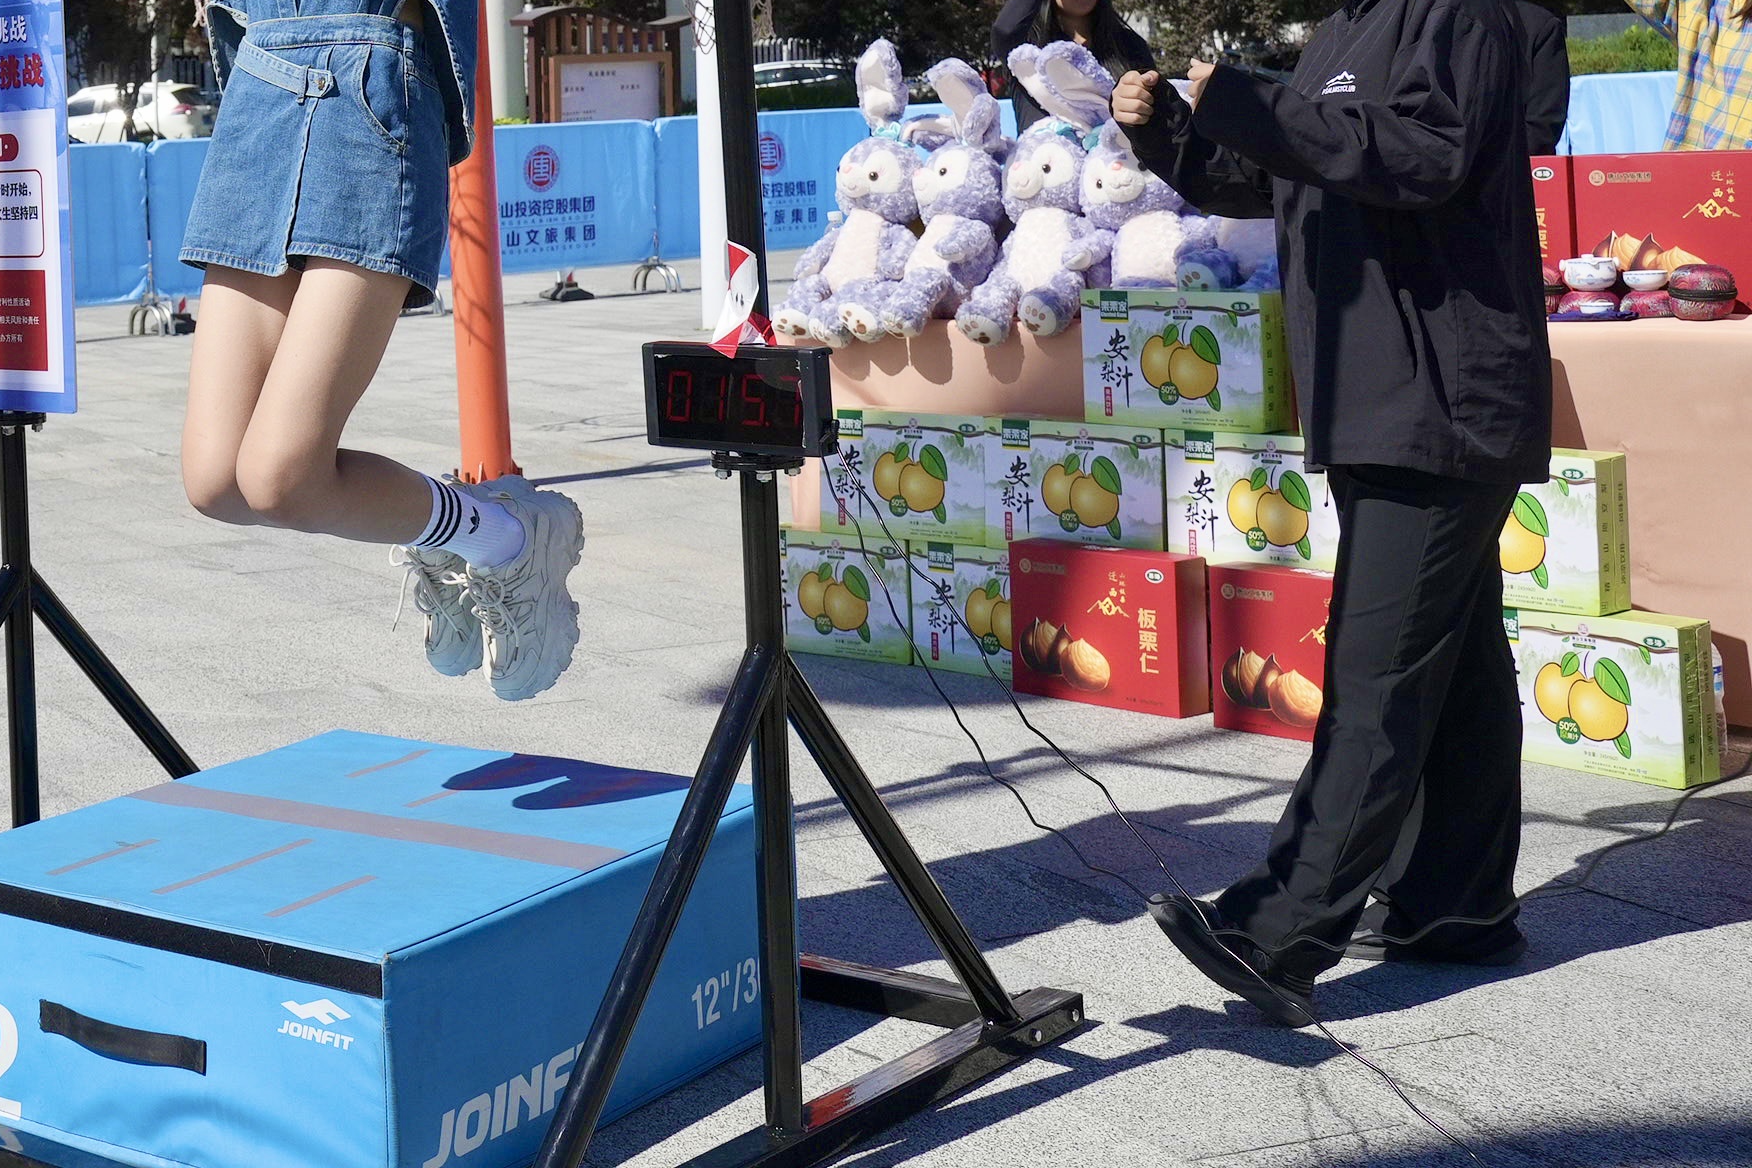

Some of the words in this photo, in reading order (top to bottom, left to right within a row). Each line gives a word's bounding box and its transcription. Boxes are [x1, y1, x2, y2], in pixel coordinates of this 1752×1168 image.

[499, 196, 595, 218] 山投资控股集团
[764, 207, 817, 225] 旅集团
[1137, 607, 1160, 675] 板栗仁
[1559, 720, 1578, 733] 50%
[691, 956, 762, 1030] 12"/3
[277, 1019, 355, 1051] JOINFIT
[422, 1040, 585, 1168] JOINF
